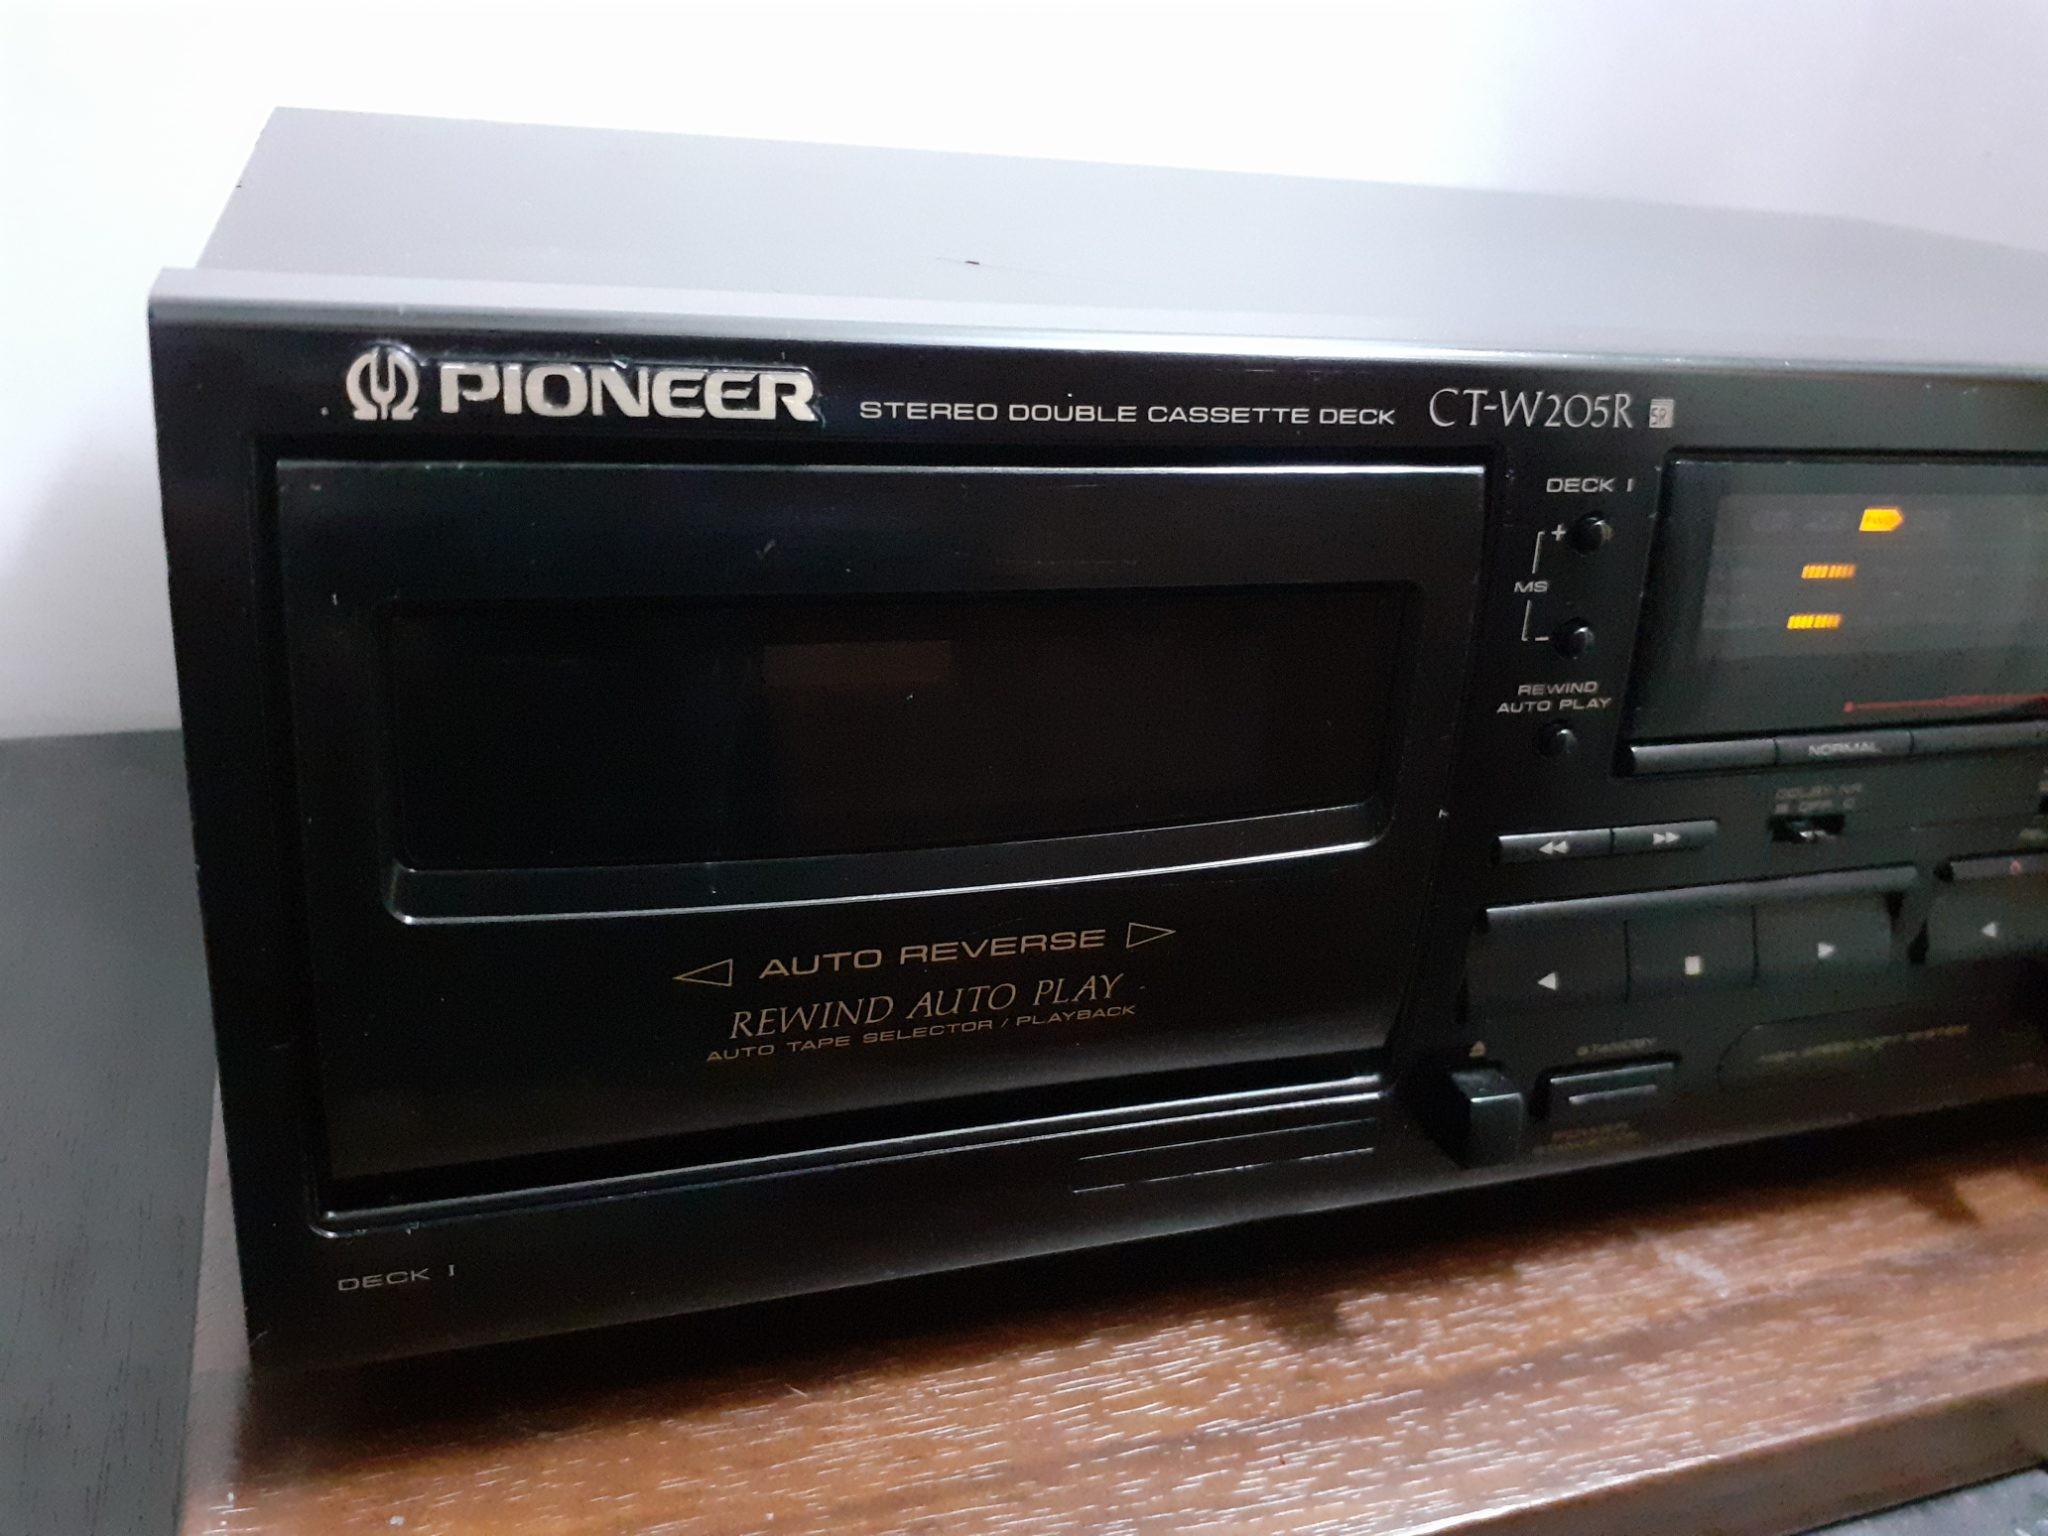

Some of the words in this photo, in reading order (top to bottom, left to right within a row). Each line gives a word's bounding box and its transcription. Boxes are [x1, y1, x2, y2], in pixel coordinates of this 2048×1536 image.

[439, 361, 818, 422] PIONEER
[859, 401, 998, 422] STEREO
[1008, 403, 1137, 423] DOUBLE
[1147, 405, 1310, 425] CASSETTE
[1318, 408, 1396, 425] DECK
[1428, 387, 1634, 429] CT-W205R
[1546, 477, 1616, 493] DECK
[1513, 580, 1549, 593] MS
[1517, 681, 1599, 697] REWIND
[1497, 700, 1550, 714] AUTO
[1558, 698, 1612, 711] PLAY
[758, 948, 884, 980] AUTO
[899, 928, 1108, 966] REVERSE
[729, 995, 895, 1041] REWIND
[905, 982, 1018, 1020] AUTO
[1033, 972, 1126, 1007] PLAY
[705, 1045, 776, 1063] AUTO
[787, 1036, 852, 1052] TAPE
[862, 1018, 995, 1045] SELECTOR
[1016, 1004, 1137, 1027] PLAYBACK
[337, 1267, 430, 1292] DECK
